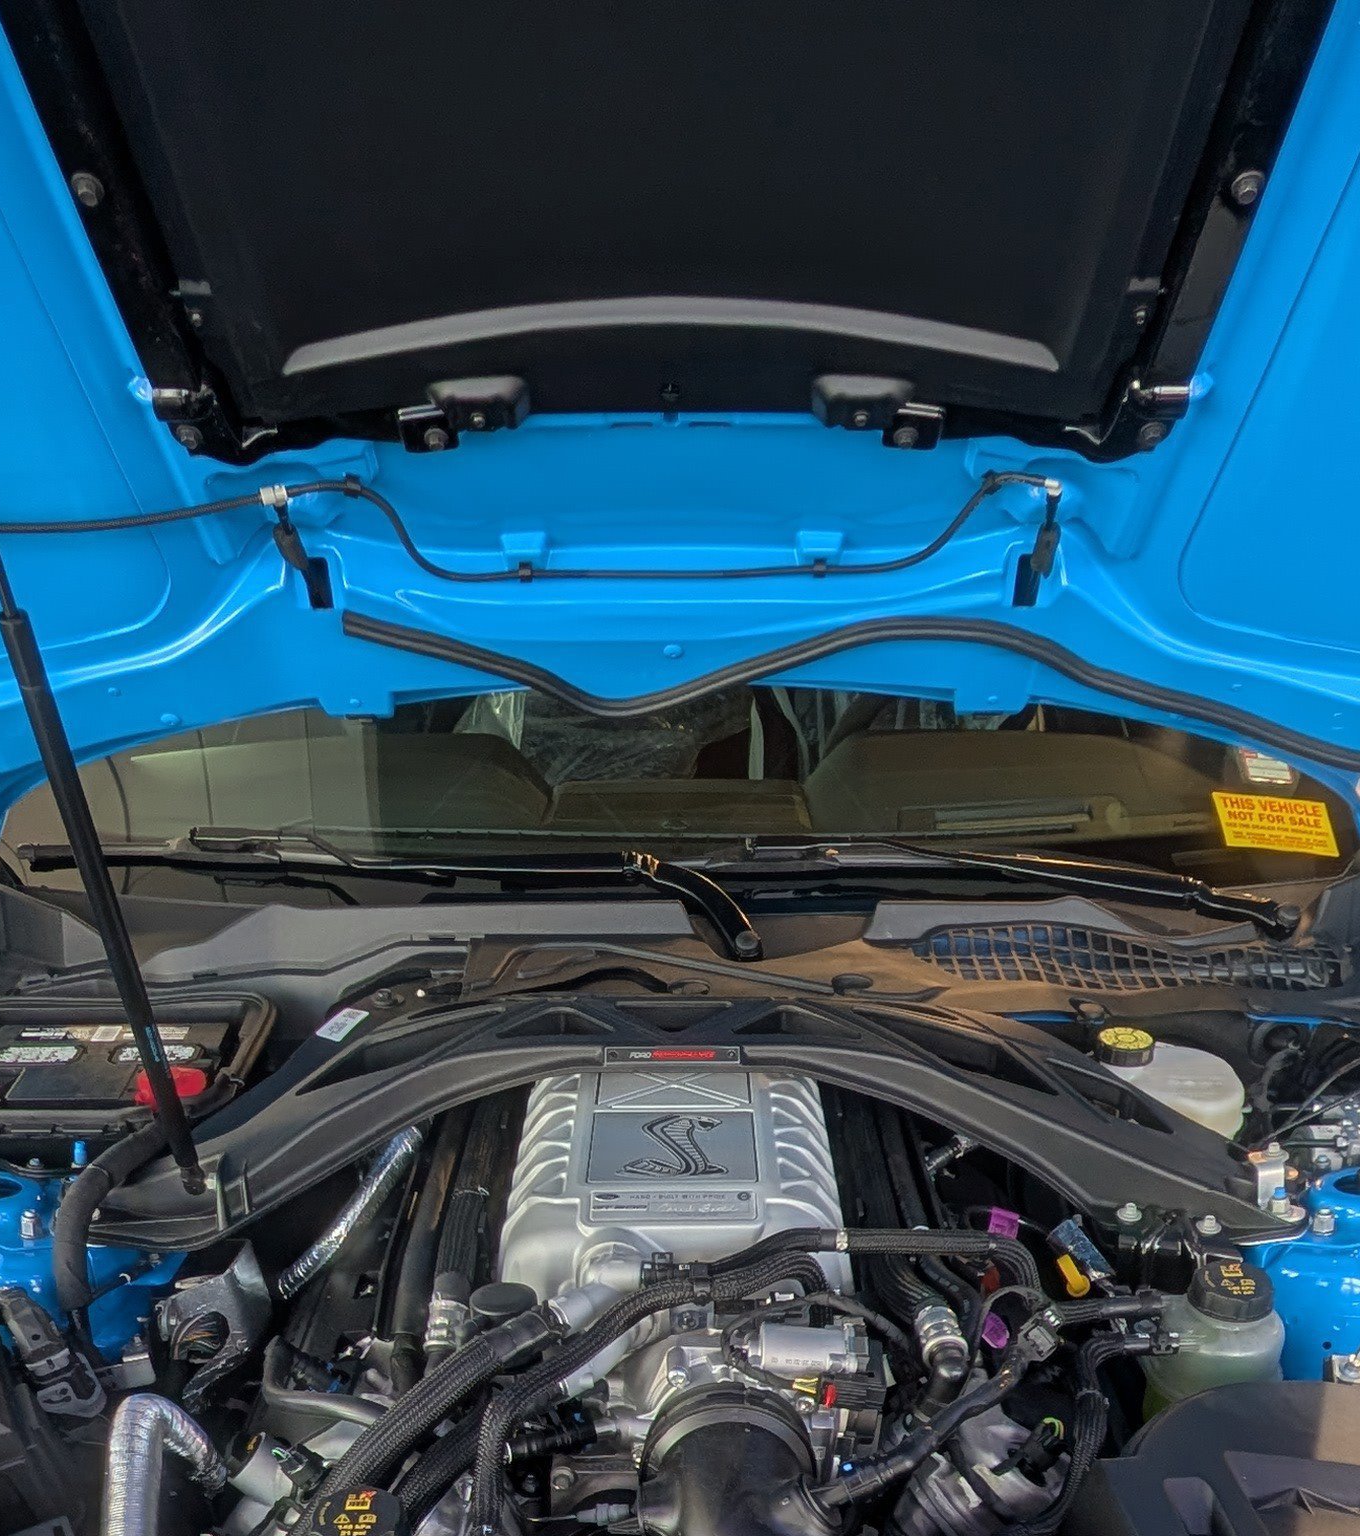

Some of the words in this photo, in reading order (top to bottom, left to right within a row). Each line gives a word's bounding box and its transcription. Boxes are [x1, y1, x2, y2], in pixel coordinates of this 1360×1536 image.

[1221, 796, 1255, 810] THIS
[1258, 799, 1322, 817] VEHICLE
[1227, 810, 1254, 822] NOT
[1258, 813, 1285, 824] FOR
[1289, 816, 1322, 828] SALE
